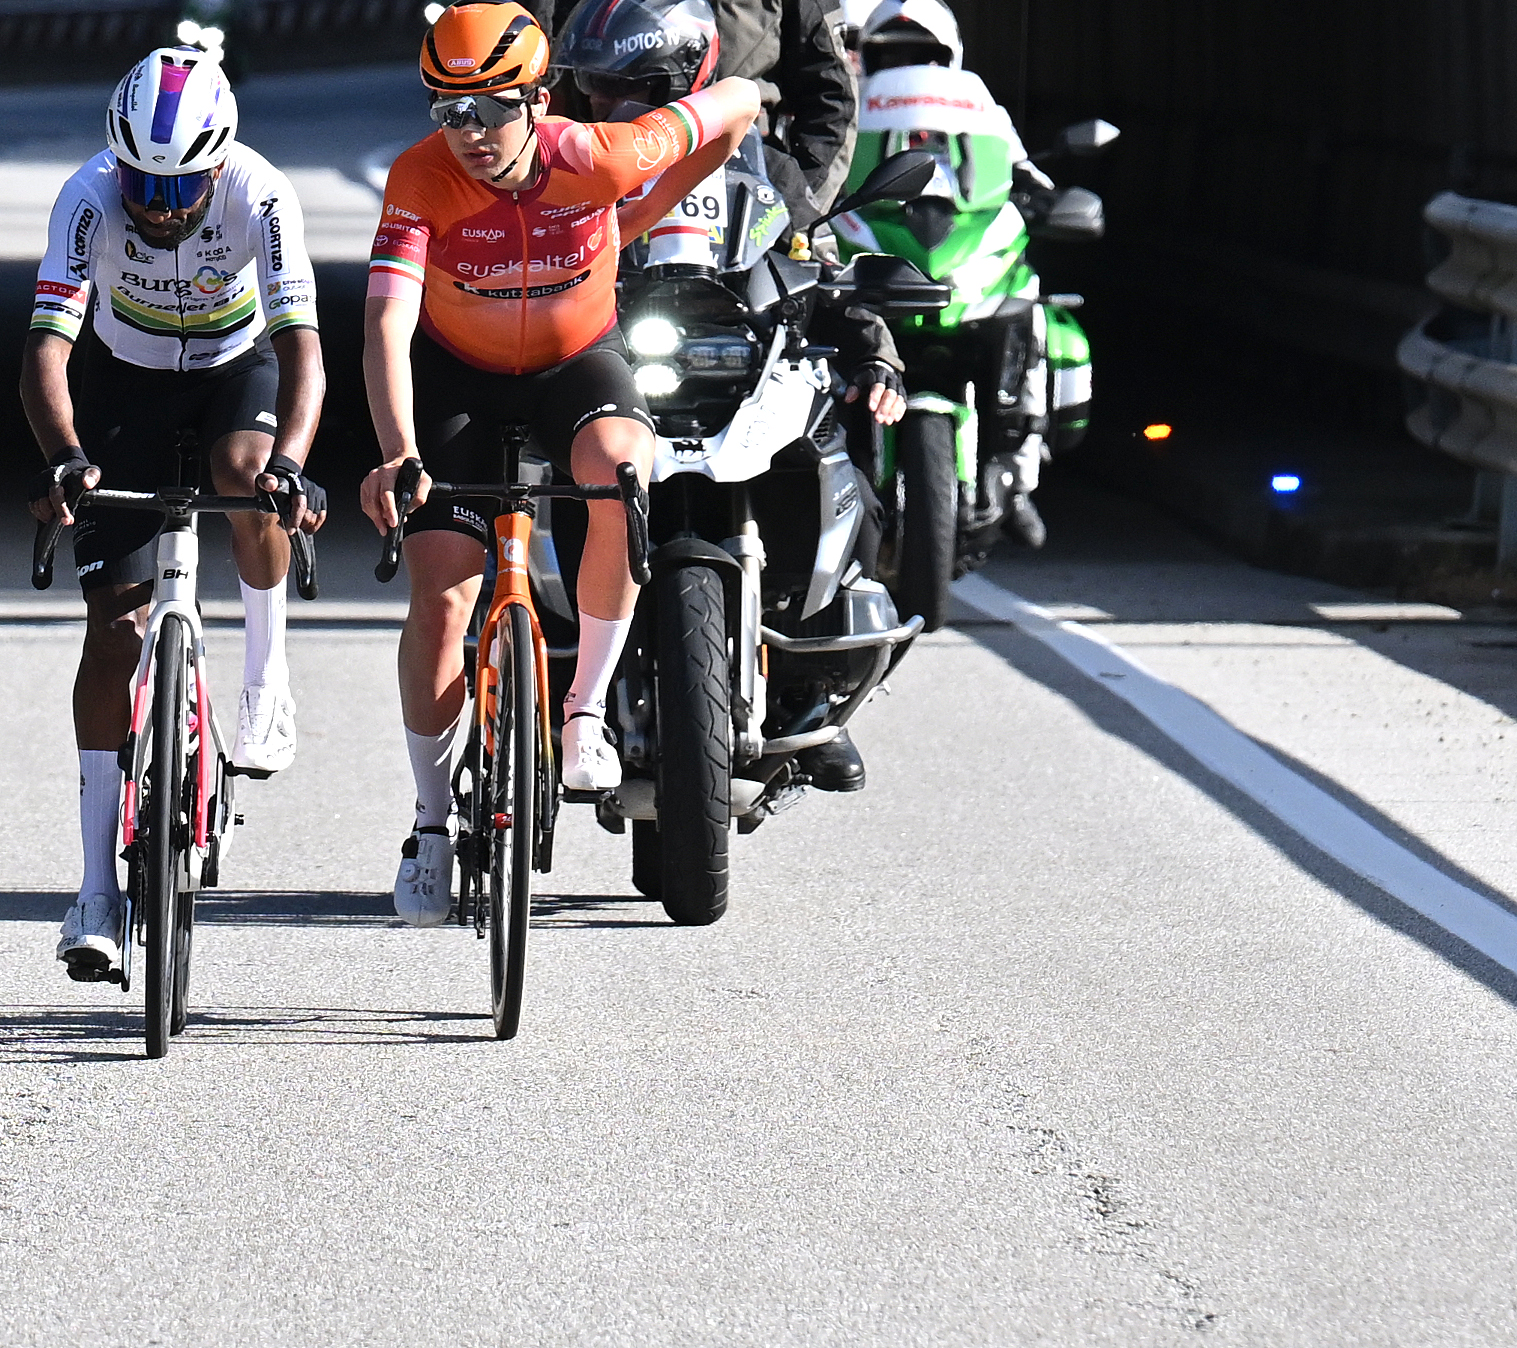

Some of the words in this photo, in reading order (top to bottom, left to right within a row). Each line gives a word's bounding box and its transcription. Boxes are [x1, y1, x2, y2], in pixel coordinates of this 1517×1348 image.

[613, 29, 664, 55] MOTOS
[681, 193, 720, 220] 69
[74, 208, 94, 256] CORTIZO
[269, 216, 283, 272] CORTIZO
[462, 228, 505, 240] EUSKADI
[457, 245, 585, 278] euskaltel
[488, 275, 583, 298] kutxabank
[163, 569, 189, 580] BH
